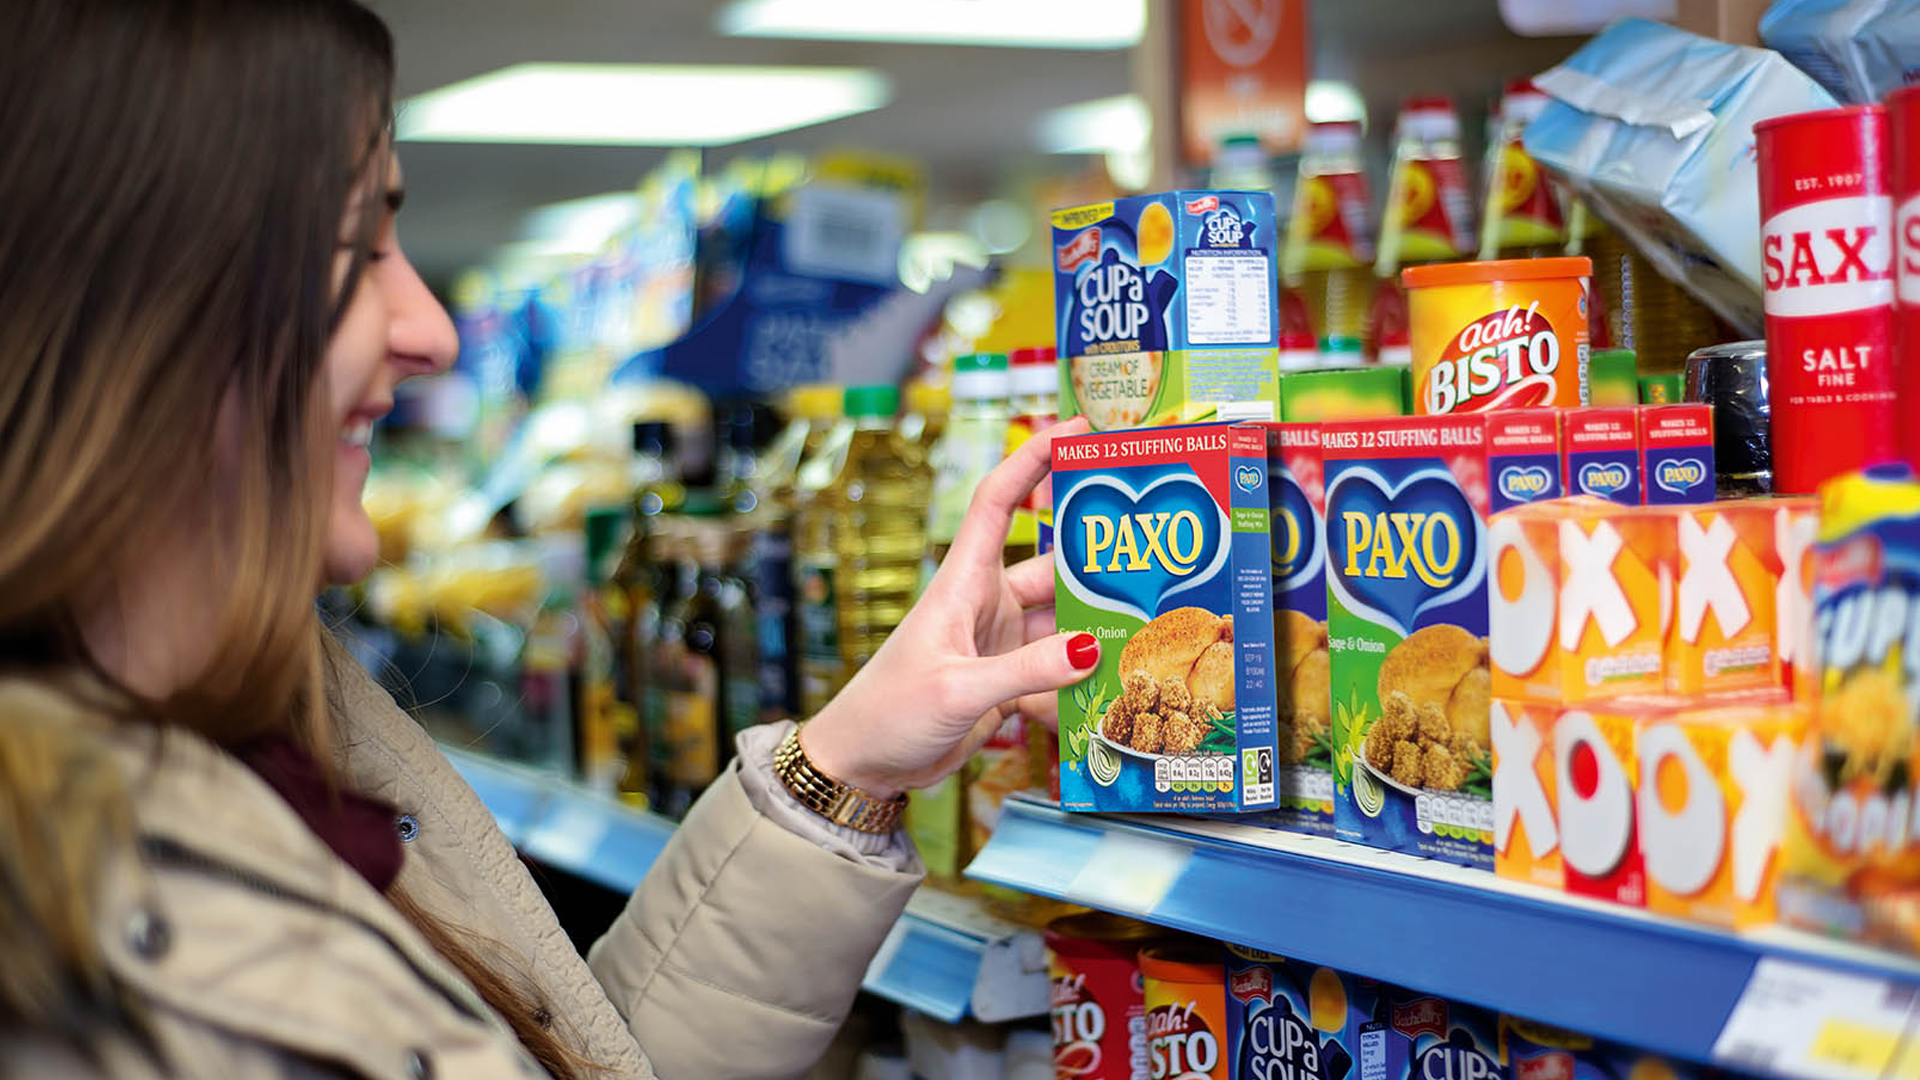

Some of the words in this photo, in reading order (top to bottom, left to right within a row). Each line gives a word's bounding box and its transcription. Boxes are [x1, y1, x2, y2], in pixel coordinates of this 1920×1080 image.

[1795, 177, 1823, 192] EST.
[1827, 173, 1862, 188] 1907
[1208, 231, 1244, 244] SOUP
[1080, 301, 1149, 342] SOUP
[1459, 300, 1540, 353] aah!
[1802, 346, 1873, 372] SALT
[1090, 360, 1121, 378] CREAM
[1429, 331, 1561, 416] BISTO
[1817, 372, 1856, 387] FINE
[1084, 378, 1148, 401] VEGETABLE
[1280, 430, 1320, 446] BALLS
[1361, 432, 1375, 448] 12
[1376, 428, 1437, 448] STUFFING
[1440, 426, 1483, 446] BALLS
[1057, 443, 1100, 461] MAKES
[1104, 443, 1118, 458] 12
[1120, 437, 1183, 456] STUFFING
[1186, 434, 1227, 451] BALLS
[1507, 475, 1544, 492] PAXO
[1587, 471, 1623, 488] PAXO
[1663, 466, 1699, 484] PAXO
[1081, 509, 1204, 576] PAXO
[1342, 511, 1462, 589] PAXO
[1096, 625, 1128, 639] Onion
[1356, 636, 1386, 653] Onion
